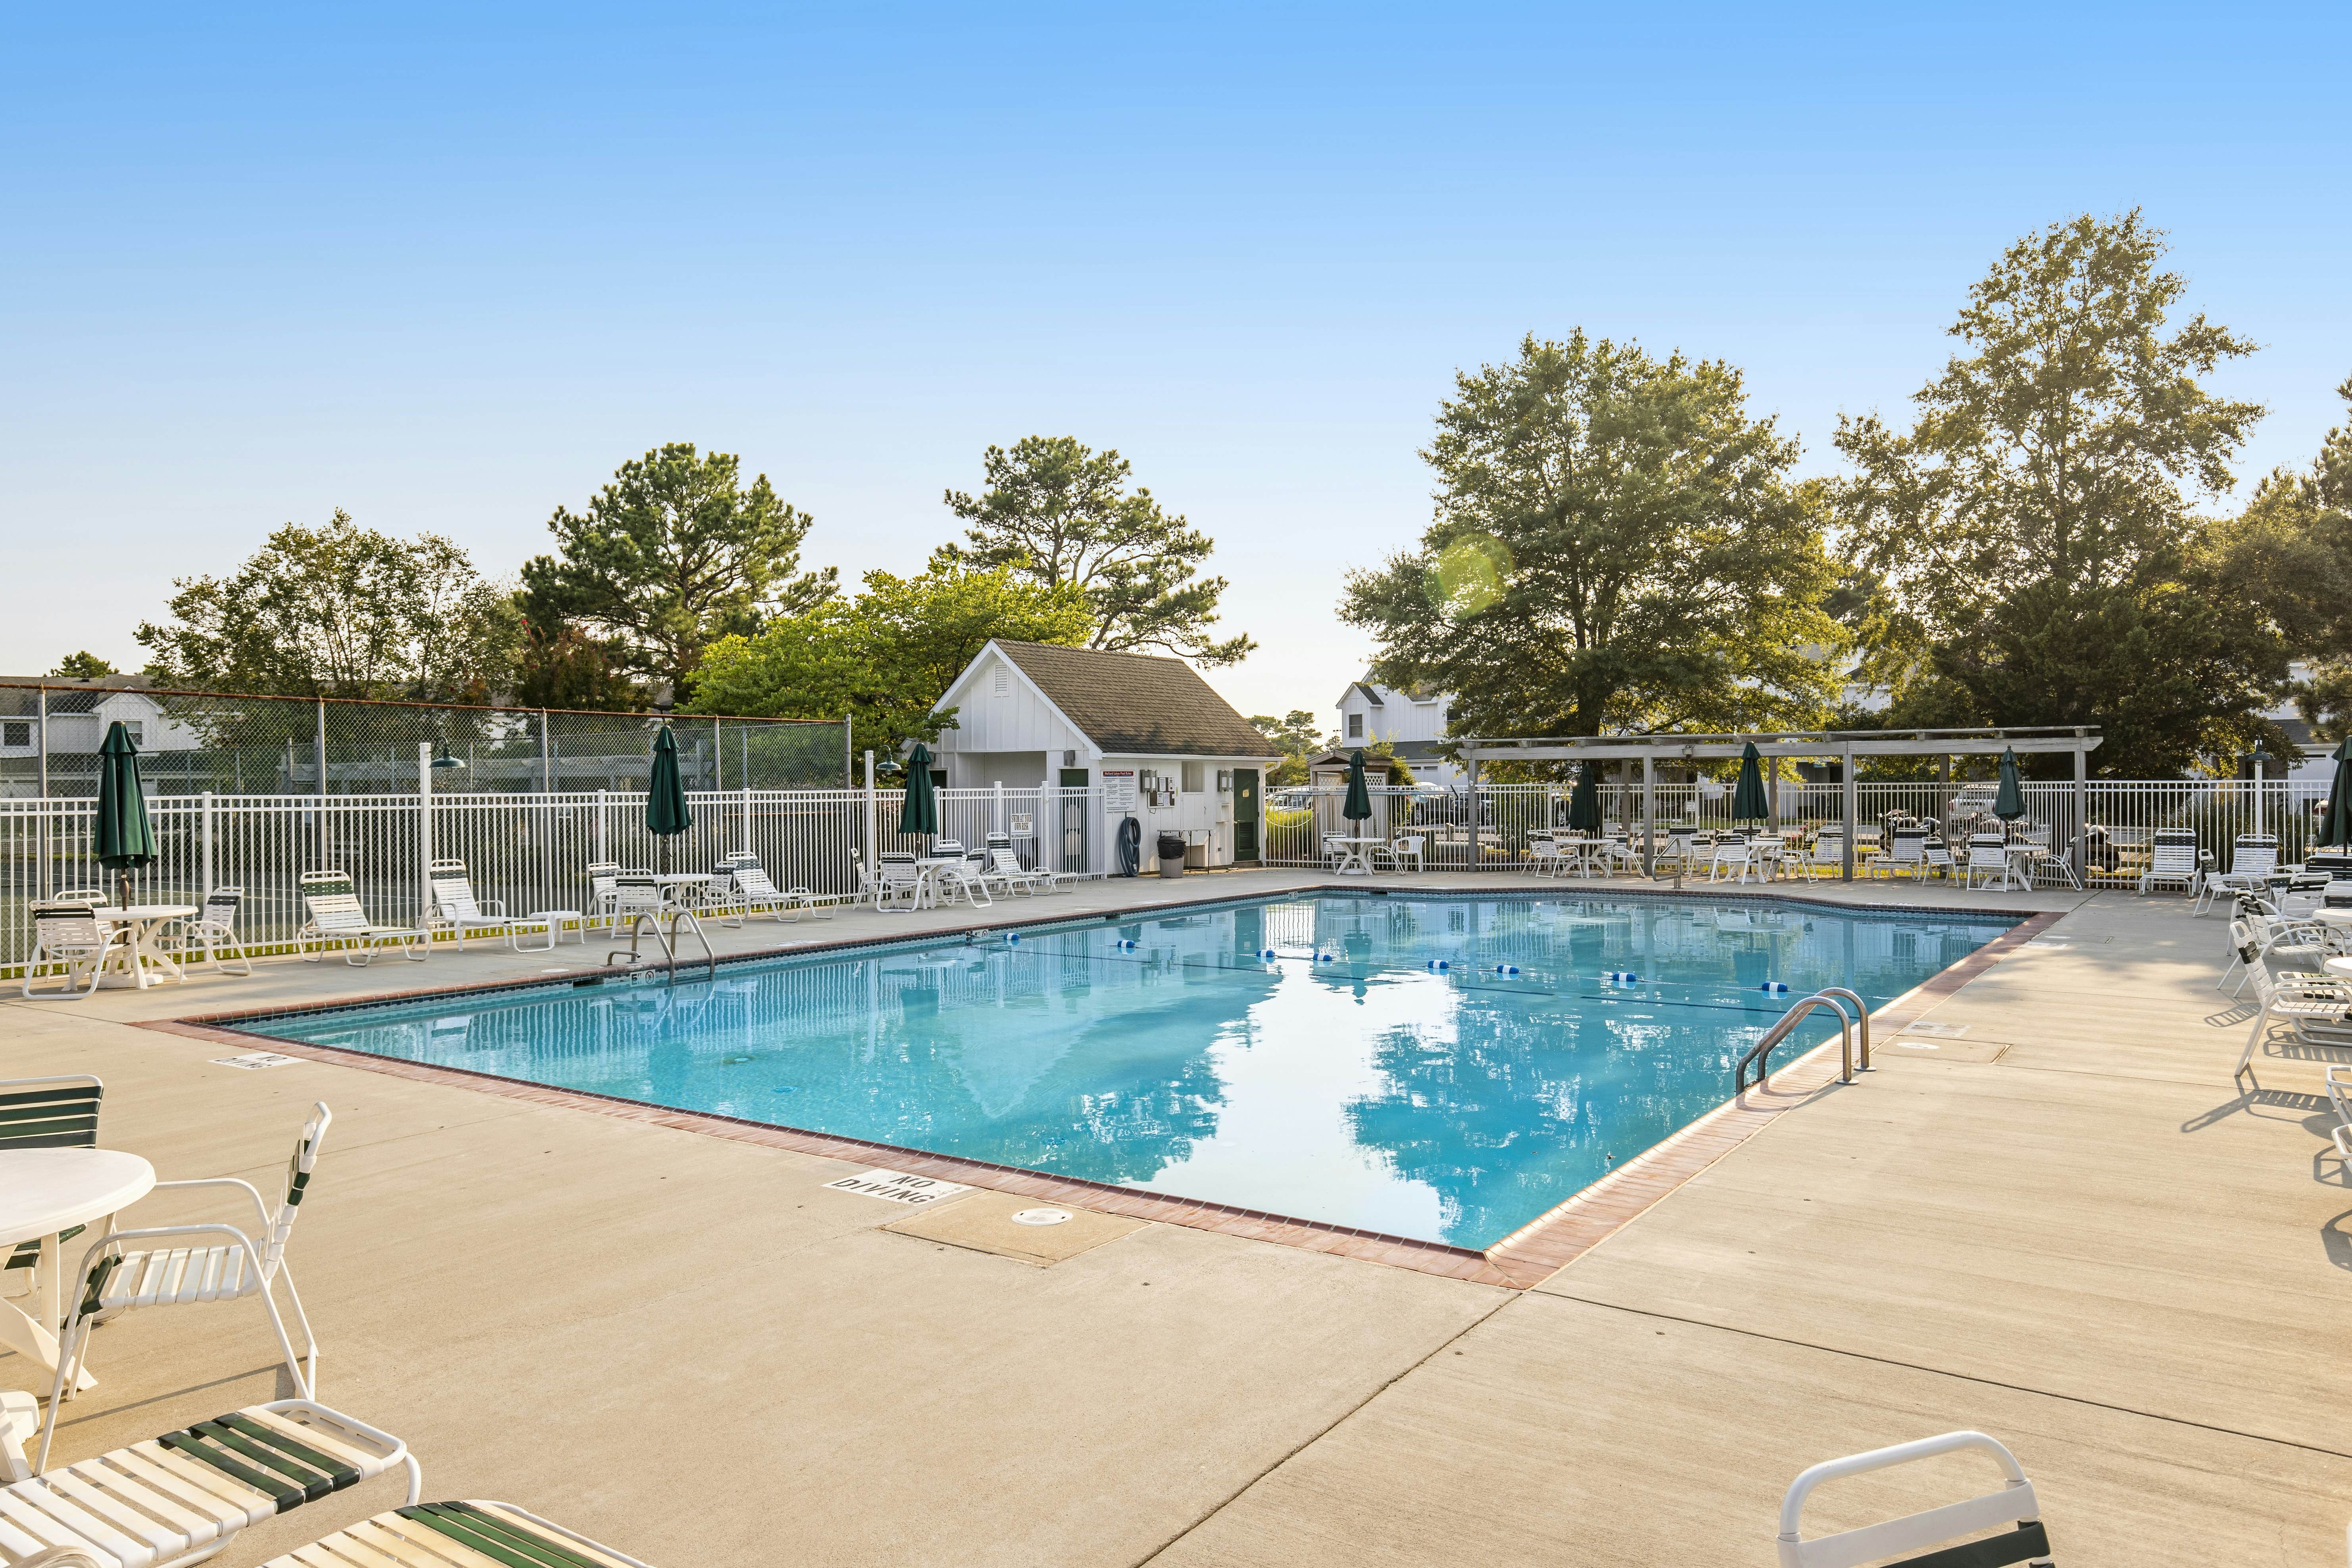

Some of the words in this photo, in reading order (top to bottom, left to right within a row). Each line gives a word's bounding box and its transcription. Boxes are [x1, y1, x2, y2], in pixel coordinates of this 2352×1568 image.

[214, 1057, 272, 1068] DIVING
[889, 1176, 936, 1188] NO
[831, 1179, 935, 1203] DIVING
